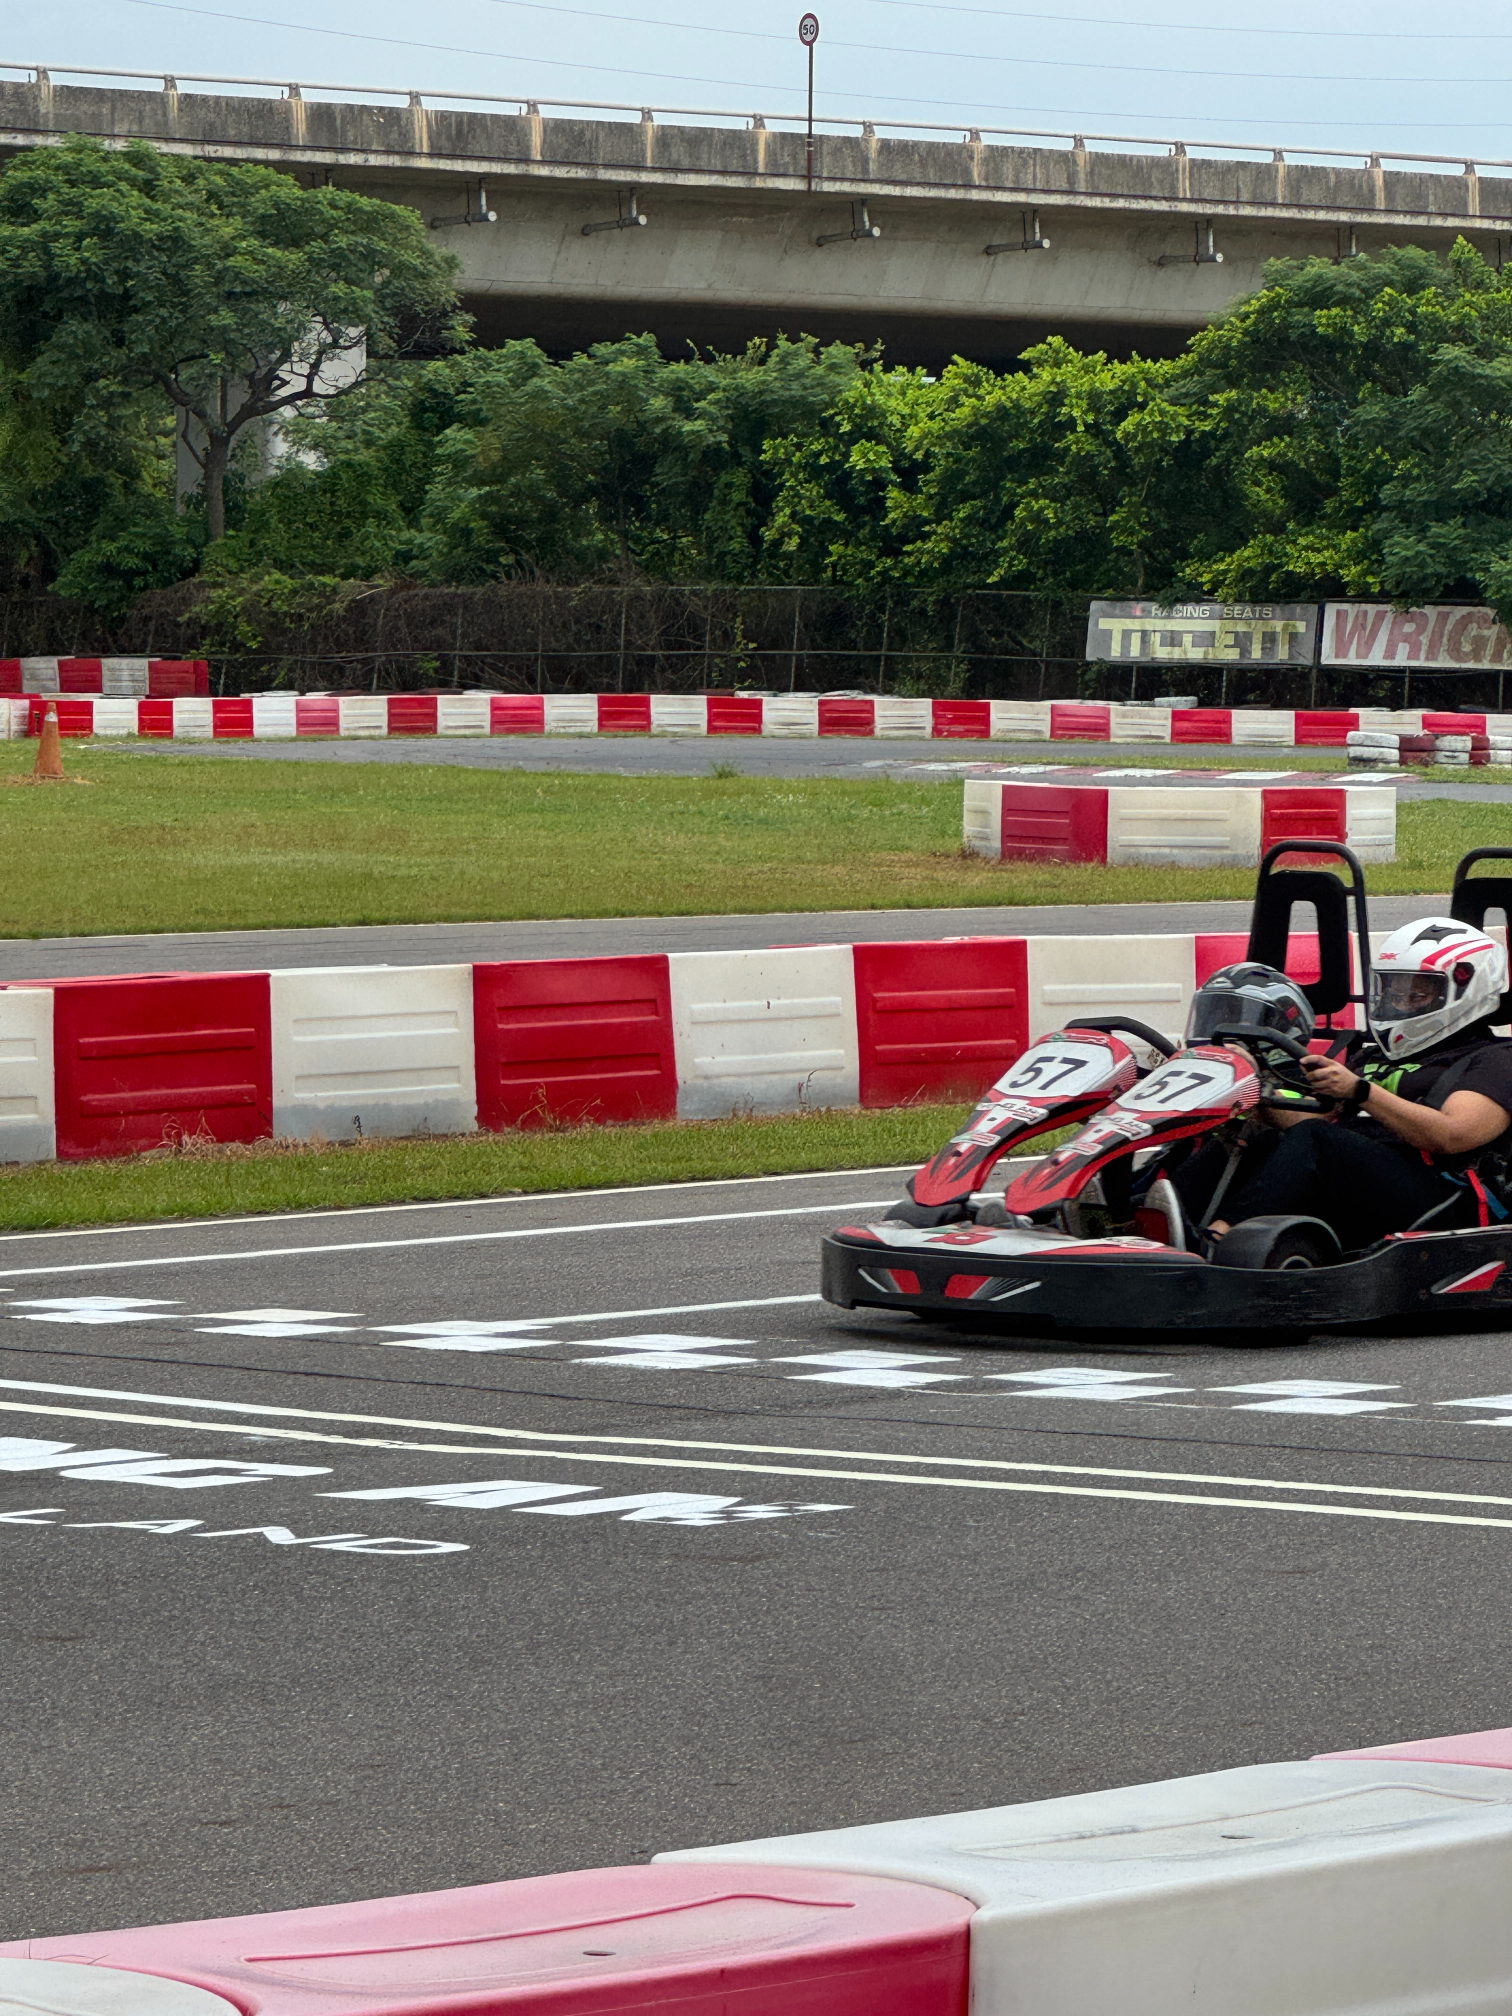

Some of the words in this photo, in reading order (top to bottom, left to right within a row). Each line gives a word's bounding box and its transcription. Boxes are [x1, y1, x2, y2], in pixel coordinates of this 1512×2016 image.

[803, 24, 815, 36] 50
[1223, 606, 1273, 618] SEATS
[1098, 618, 1307, 660] TILLETT
[1008, 1055, 1090, 1091] 57
[1134, 1070, 1216, 1104] 57
